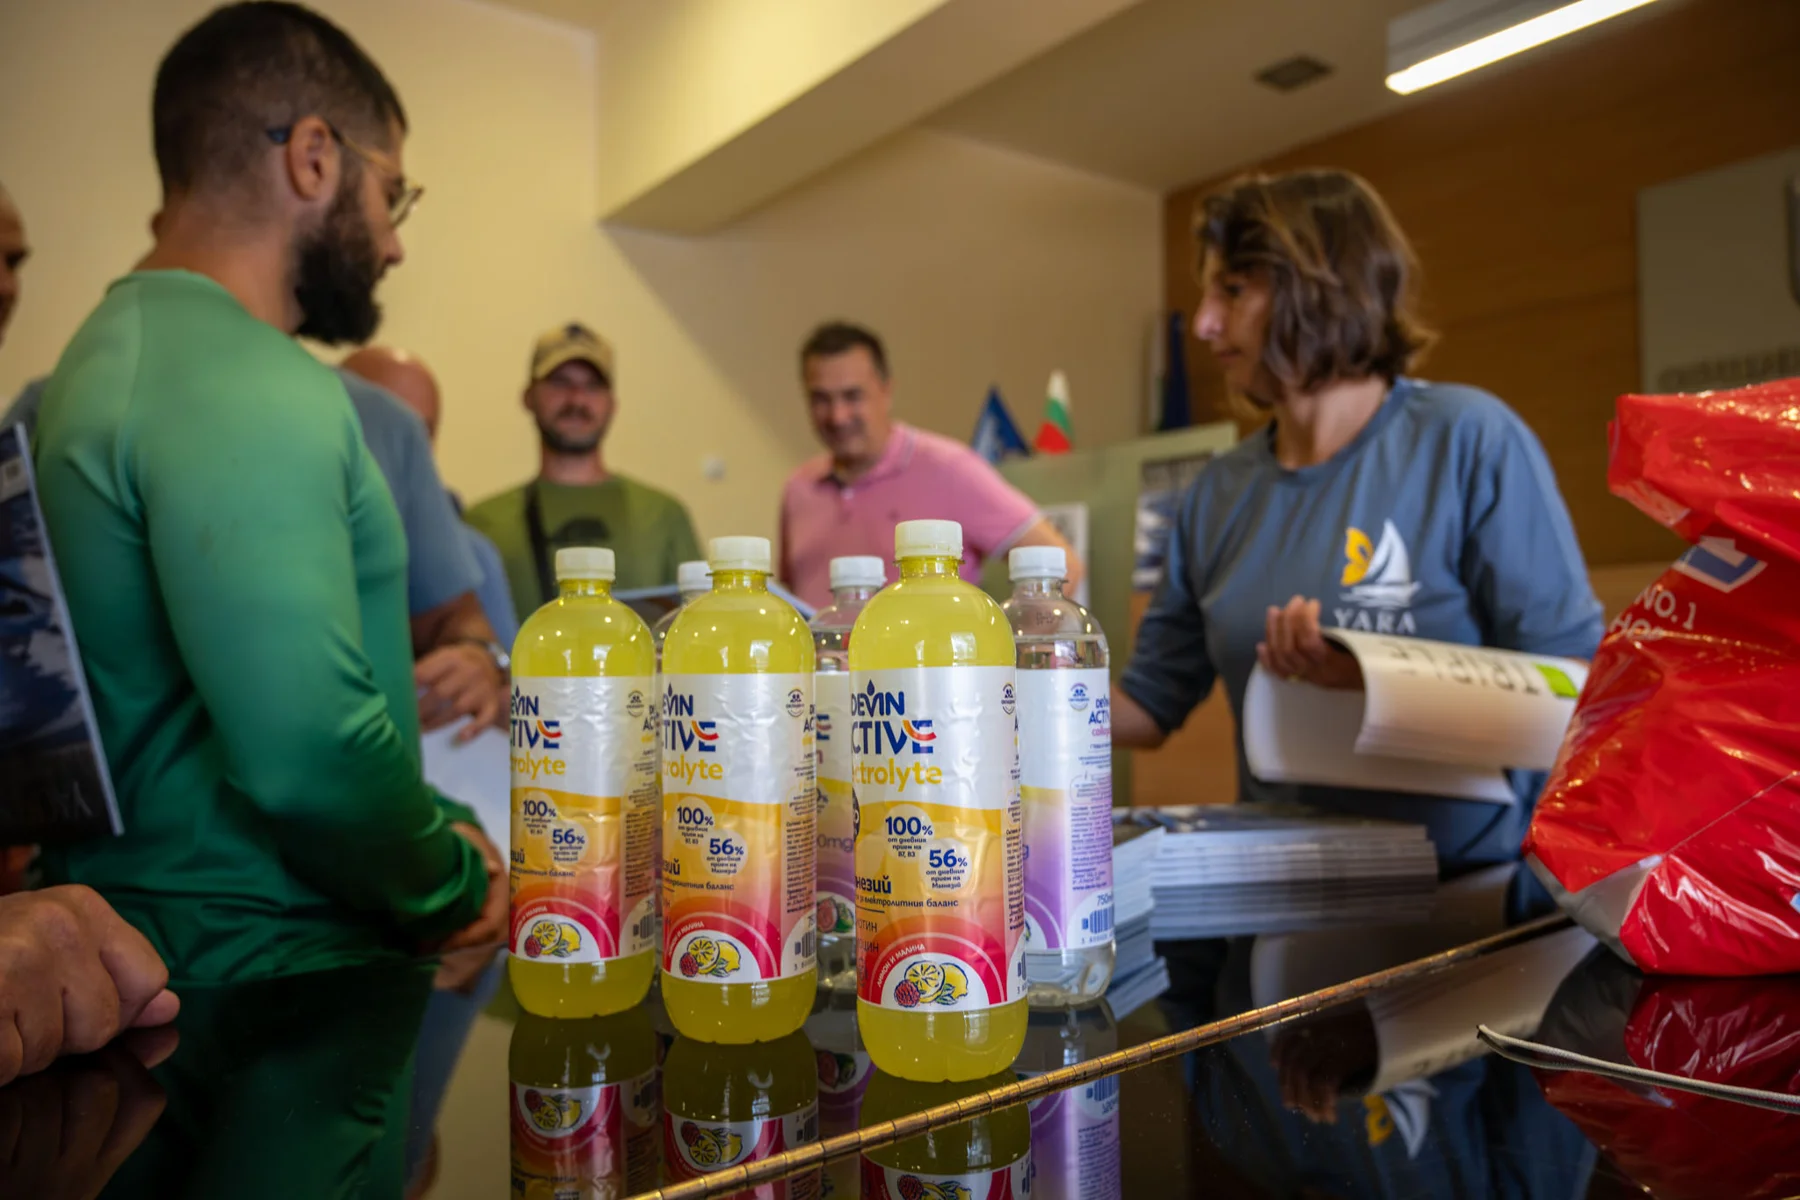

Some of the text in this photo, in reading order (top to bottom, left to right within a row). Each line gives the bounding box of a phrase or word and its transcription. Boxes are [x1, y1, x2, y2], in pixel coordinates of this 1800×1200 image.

[1333, 607, 1416, 634] YARA
[664, 719, 718, 752] TIVE
[851, 719, 935, 755] CTIVE
[523, 799, 556, 817] 100%
[677, 806, 714, 826] 100%
[885, 816, 933, 836] 100%
[552, 828, 585, 845] 56%
[709, 838, 744, 855] 56%
[929, 848, 968, 868] 56%
[854, 875, 892, 894] незий
[926, 898, 959, 907] баланс
[895, 943, 926, 960] МАЛИНА
